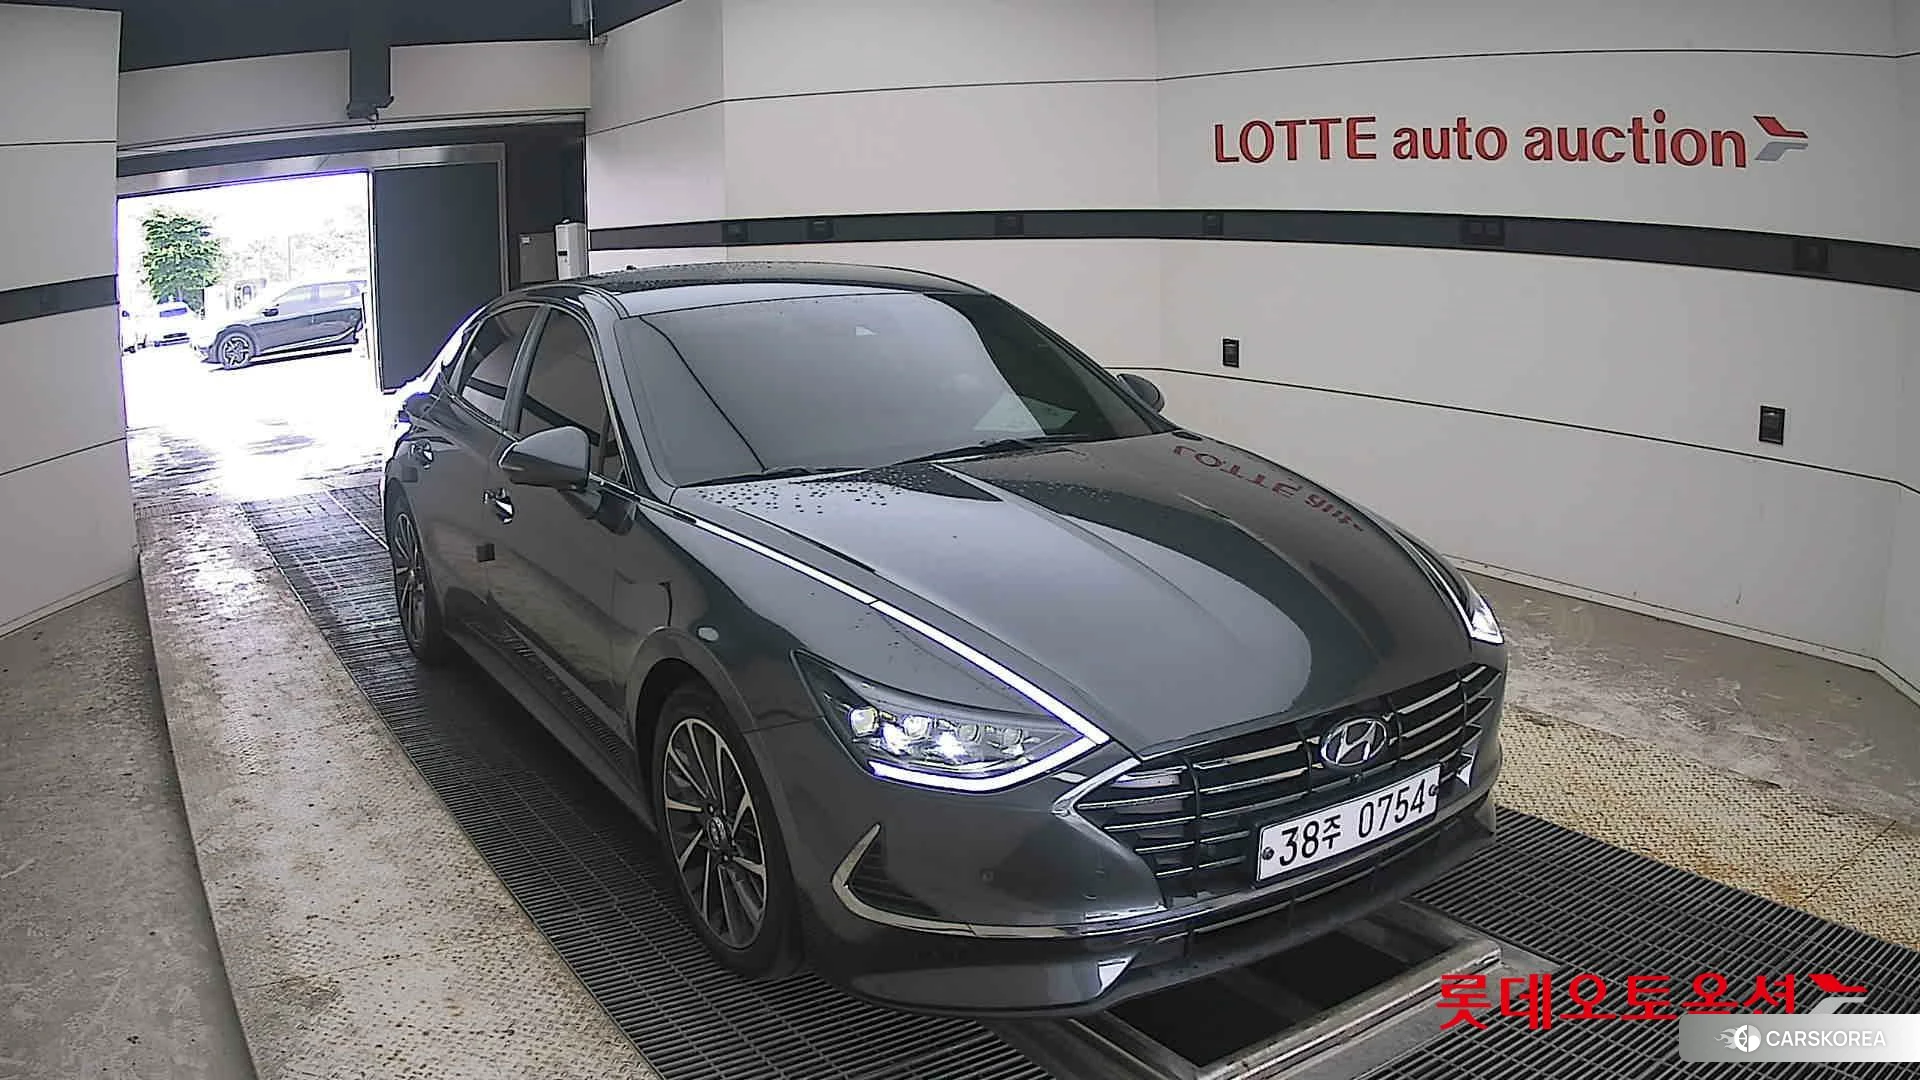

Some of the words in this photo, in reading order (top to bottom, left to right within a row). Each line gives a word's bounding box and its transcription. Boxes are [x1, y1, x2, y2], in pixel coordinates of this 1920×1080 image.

[1214, 116, 1378, 163] LOTTE
[1393, 117, 1509, 161] auto
[1523, 110, 1749, 168] auction
[1279, 814, 1341, 867] 38주
[1358, 779, 1426, 838] 0754
